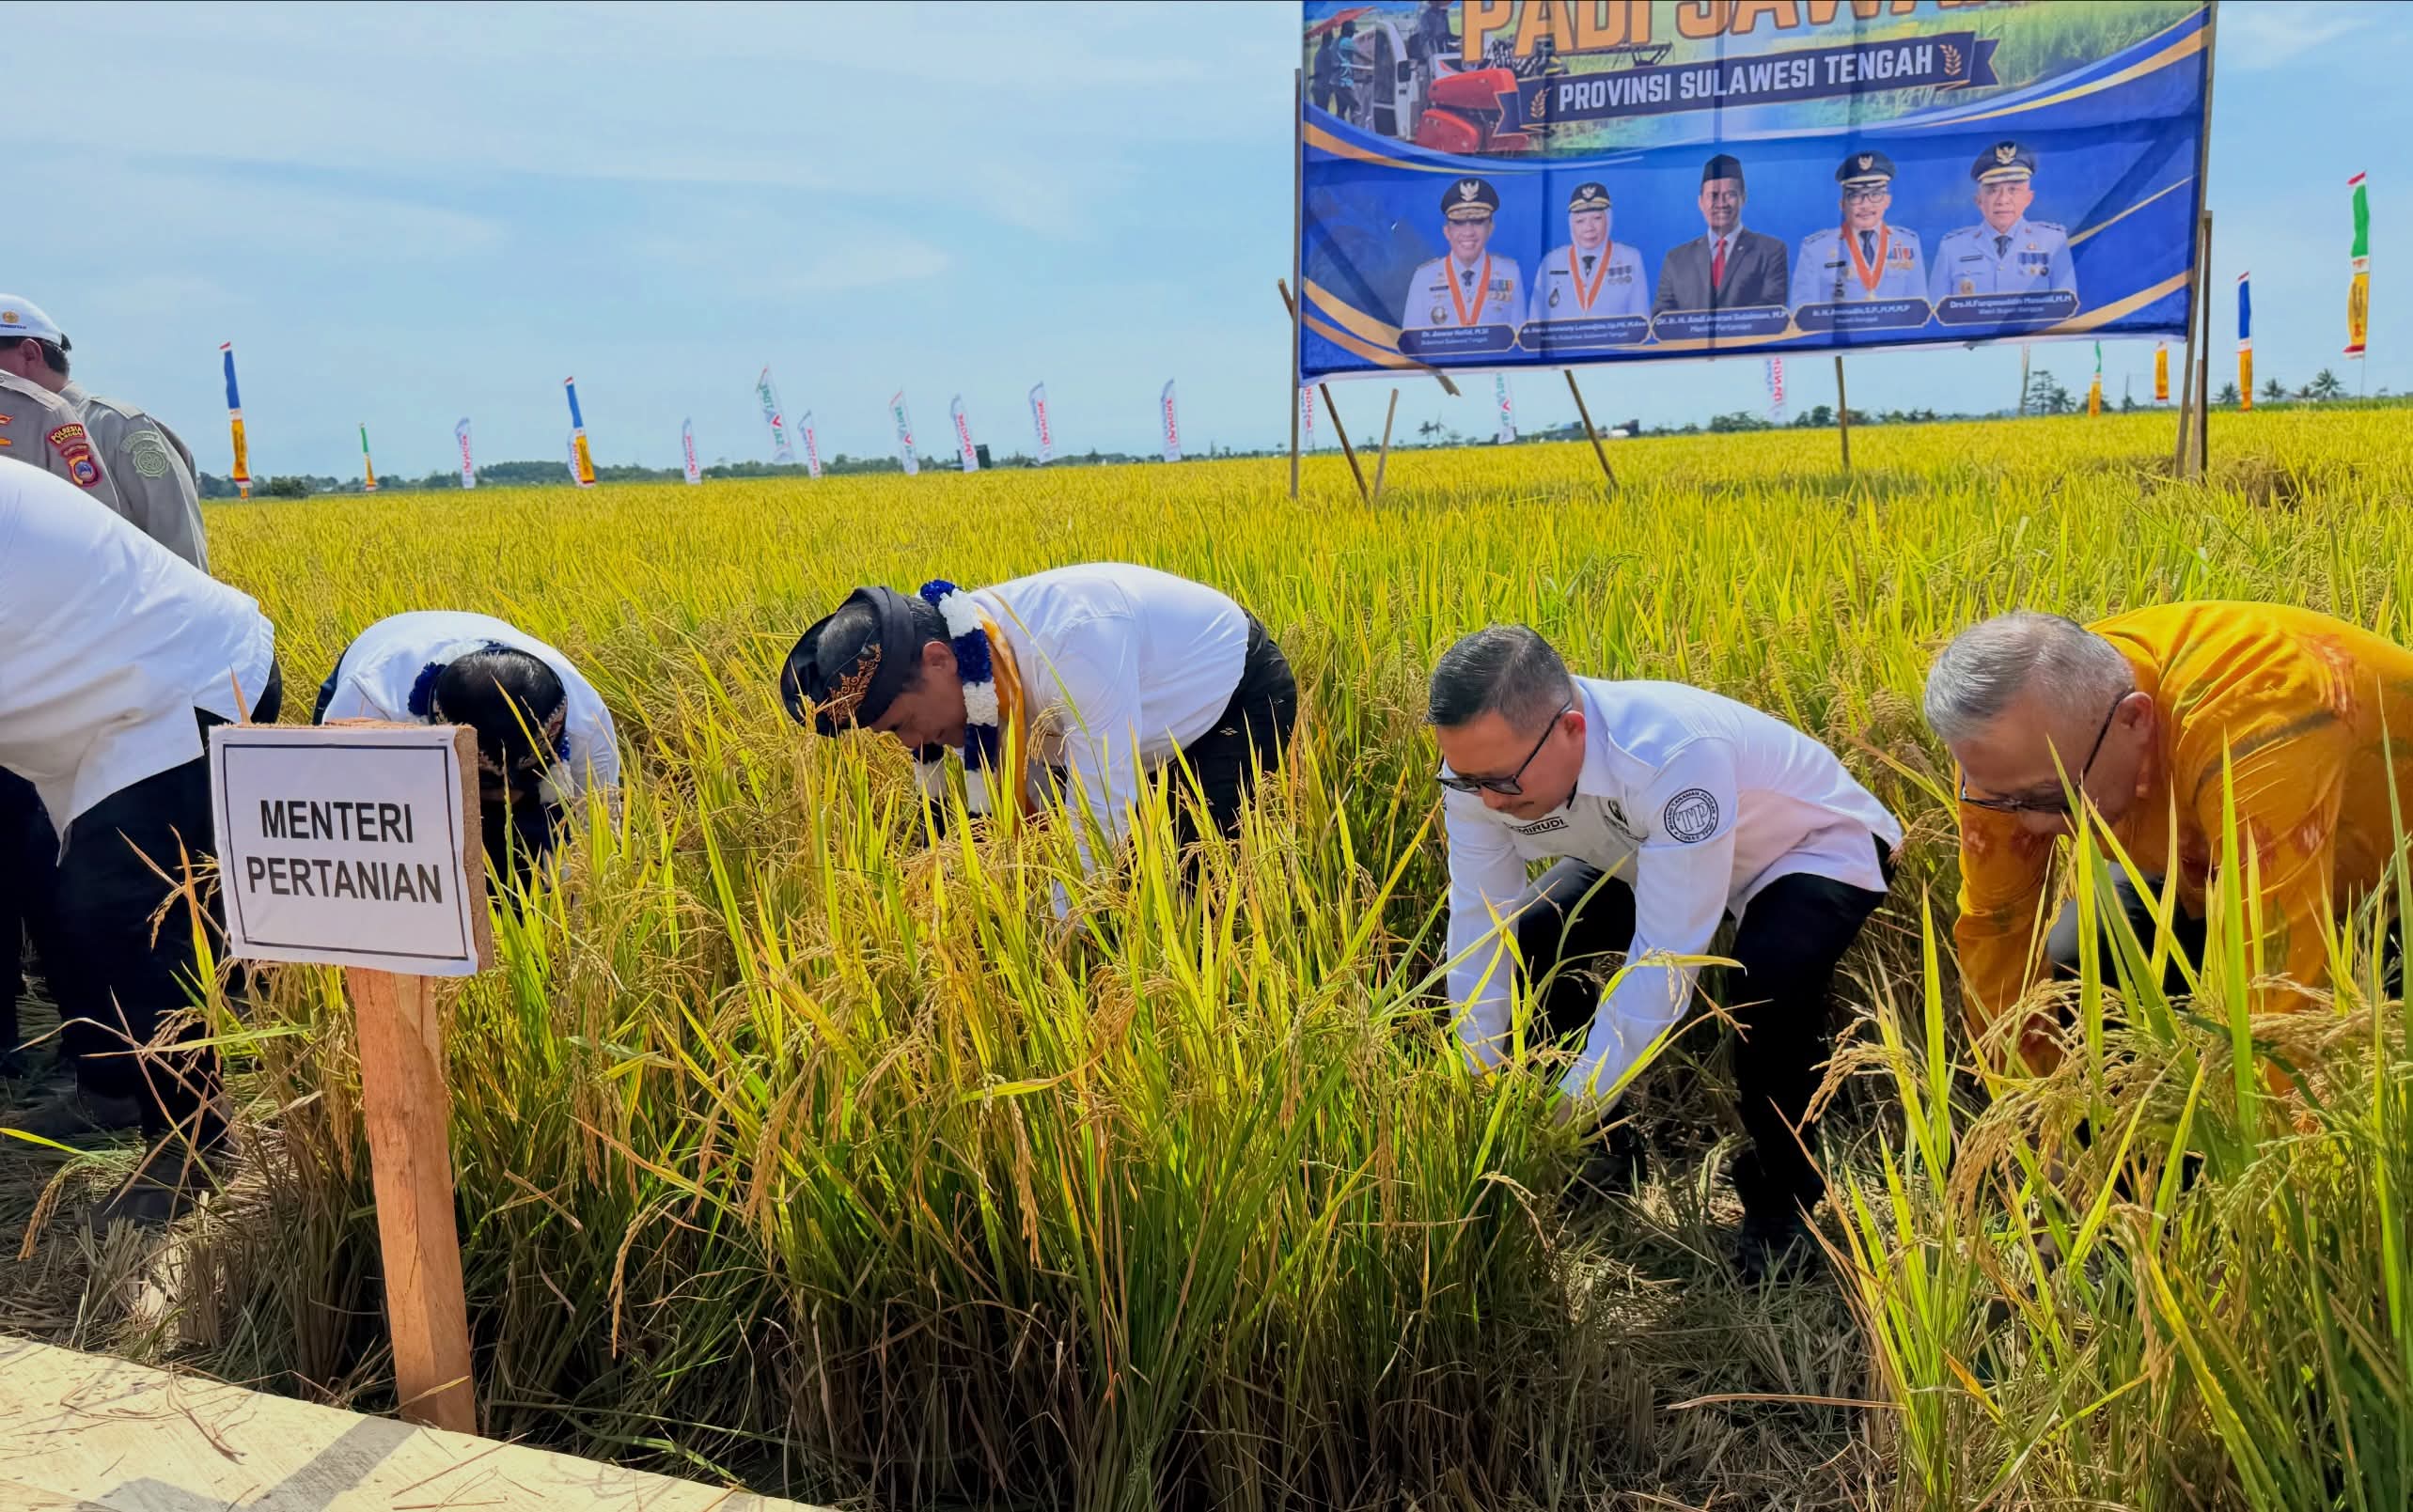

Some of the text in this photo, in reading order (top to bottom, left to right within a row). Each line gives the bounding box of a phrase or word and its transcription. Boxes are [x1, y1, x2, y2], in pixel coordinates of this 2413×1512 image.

[1462, 1, 1652, 64] PADI
[1559, 44, 1933, 112] PROVINSI SULAWESI TENGAH
[260, 800, 414, 843] MENTERI
[1675, 802, 1708, 832] TP
[246, 856, 443, 903] PERTANIAN
